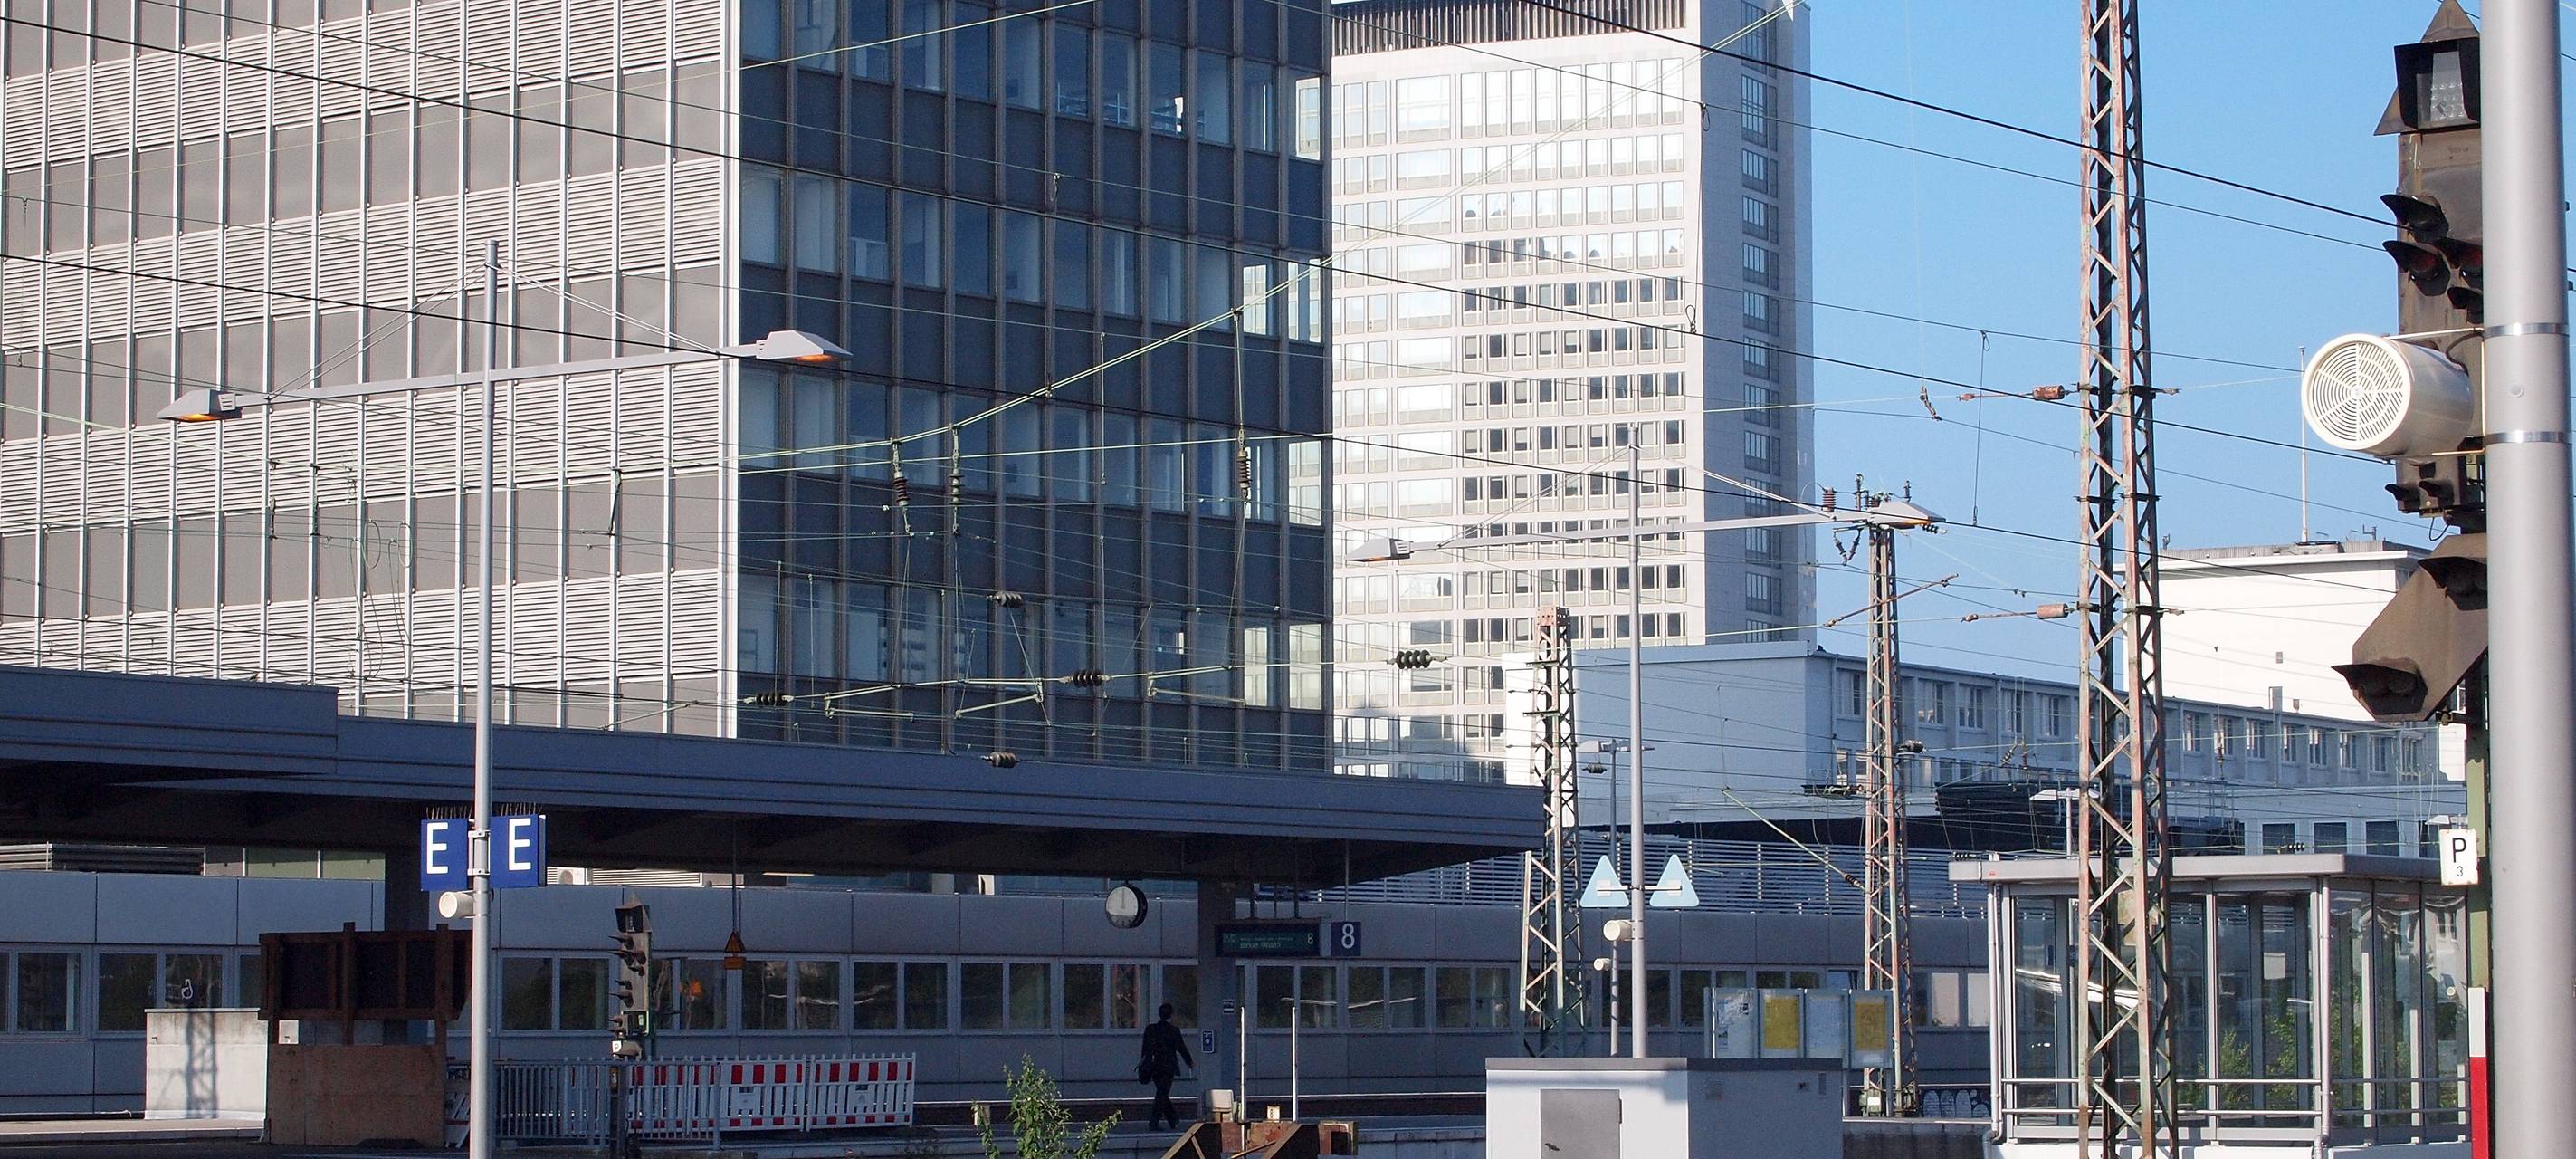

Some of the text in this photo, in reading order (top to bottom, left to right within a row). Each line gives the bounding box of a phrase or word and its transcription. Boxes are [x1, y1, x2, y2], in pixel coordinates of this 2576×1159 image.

[426, 822, 448, 874] E
[508, 818, 531, 870] E
[2452, 838, 2466, 863] P
[2457, 866, 2463, 877] 3
[1307, 933, 1313, 944] 8
[1341, 923, 1355, 949] 8
